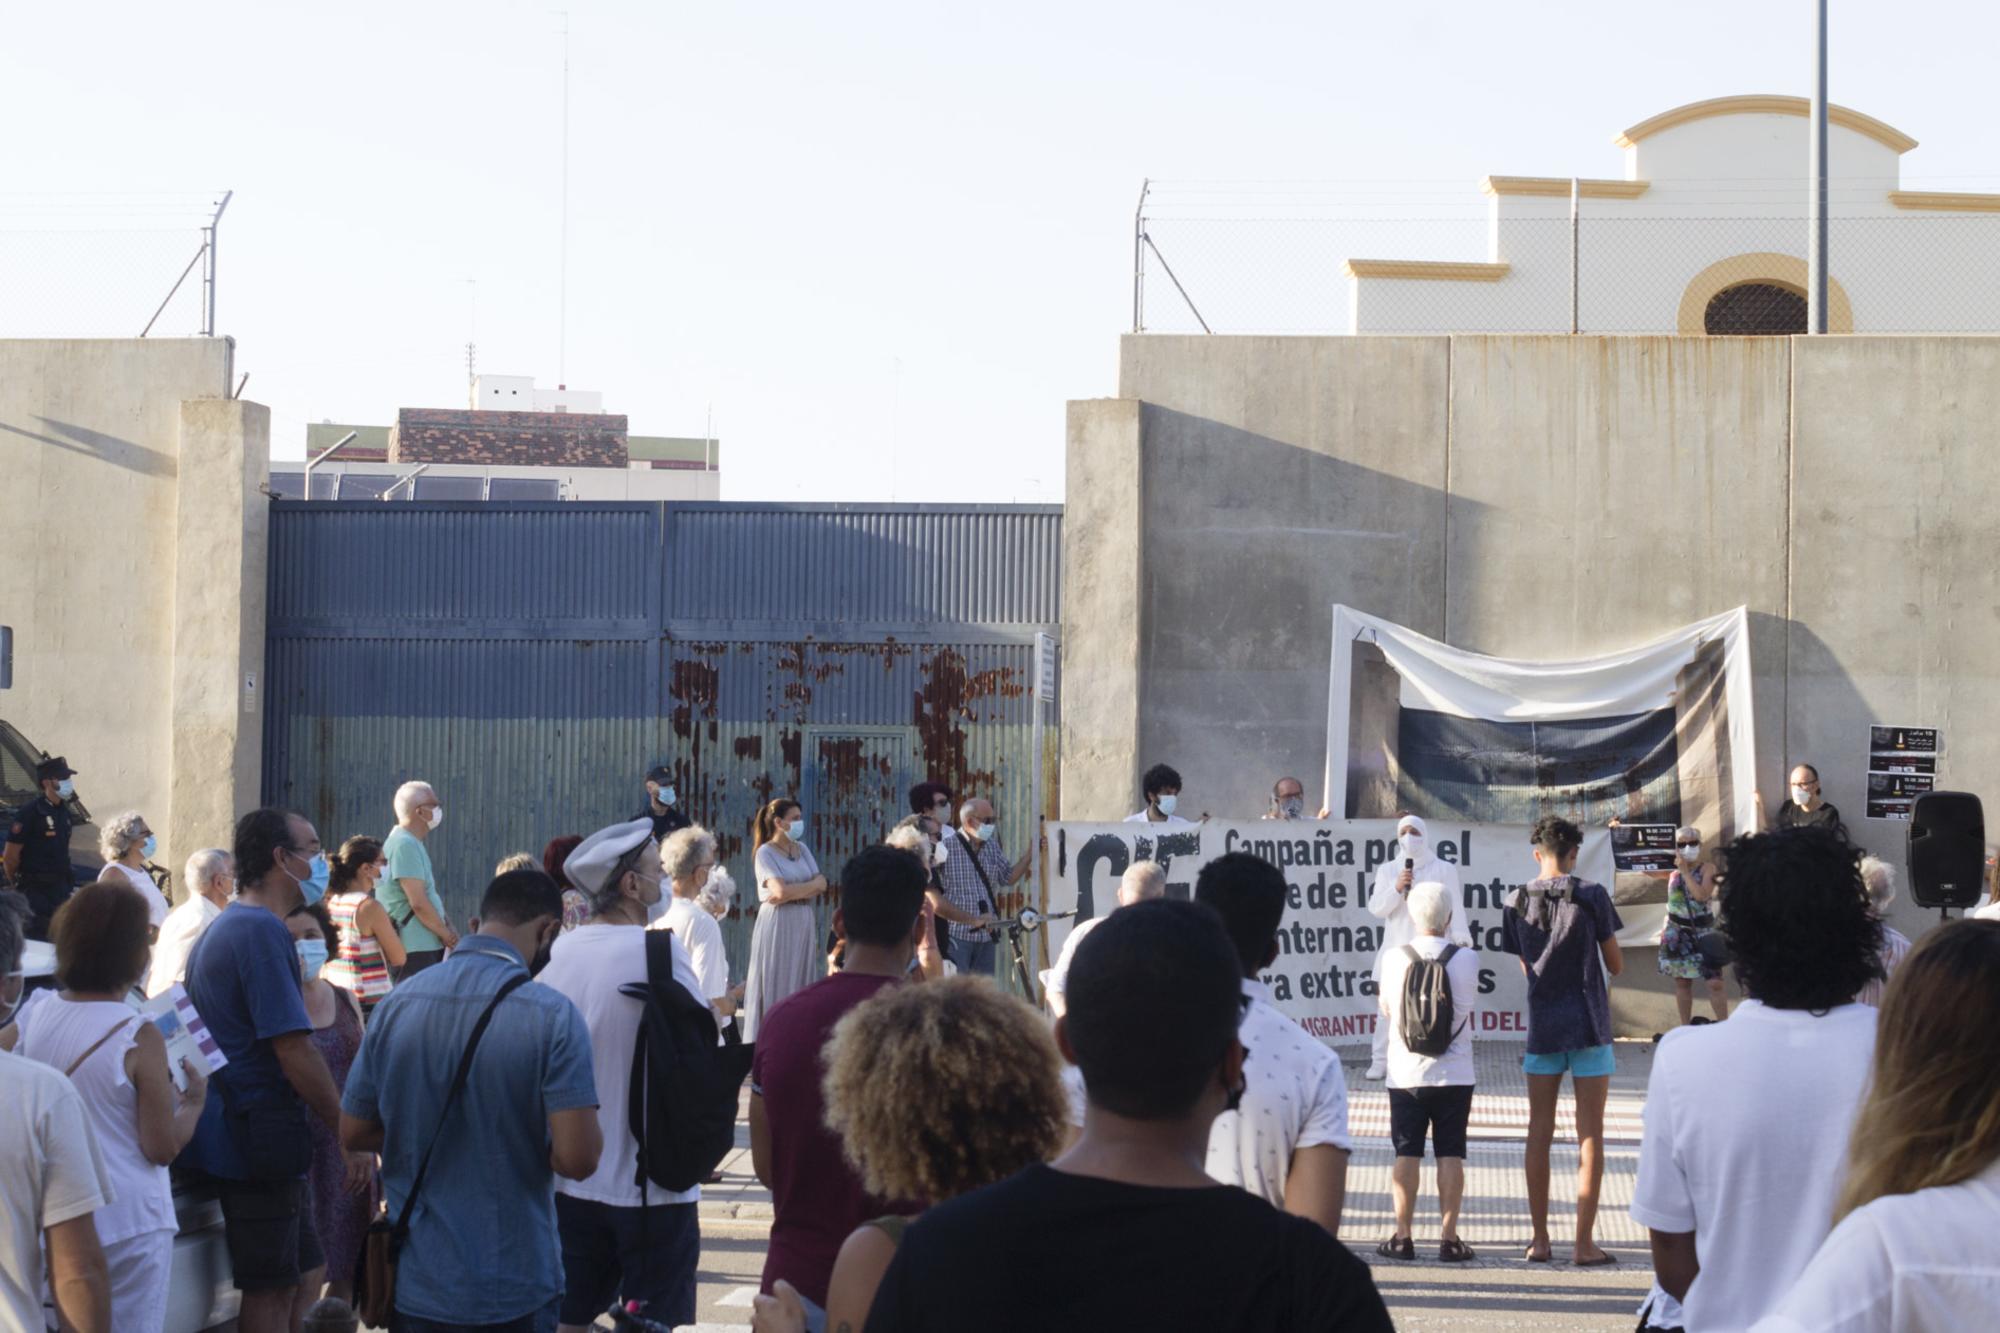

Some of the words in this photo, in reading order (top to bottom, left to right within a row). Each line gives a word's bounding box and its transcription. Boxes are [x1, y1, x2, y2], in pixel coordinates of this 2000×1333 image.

[1365, 836, 1399, 872] po
[1437, 830, 1471, 866] el
[1307, 872, 1347, 909] de
[1482, 1011, 1527, 1031] DEL
